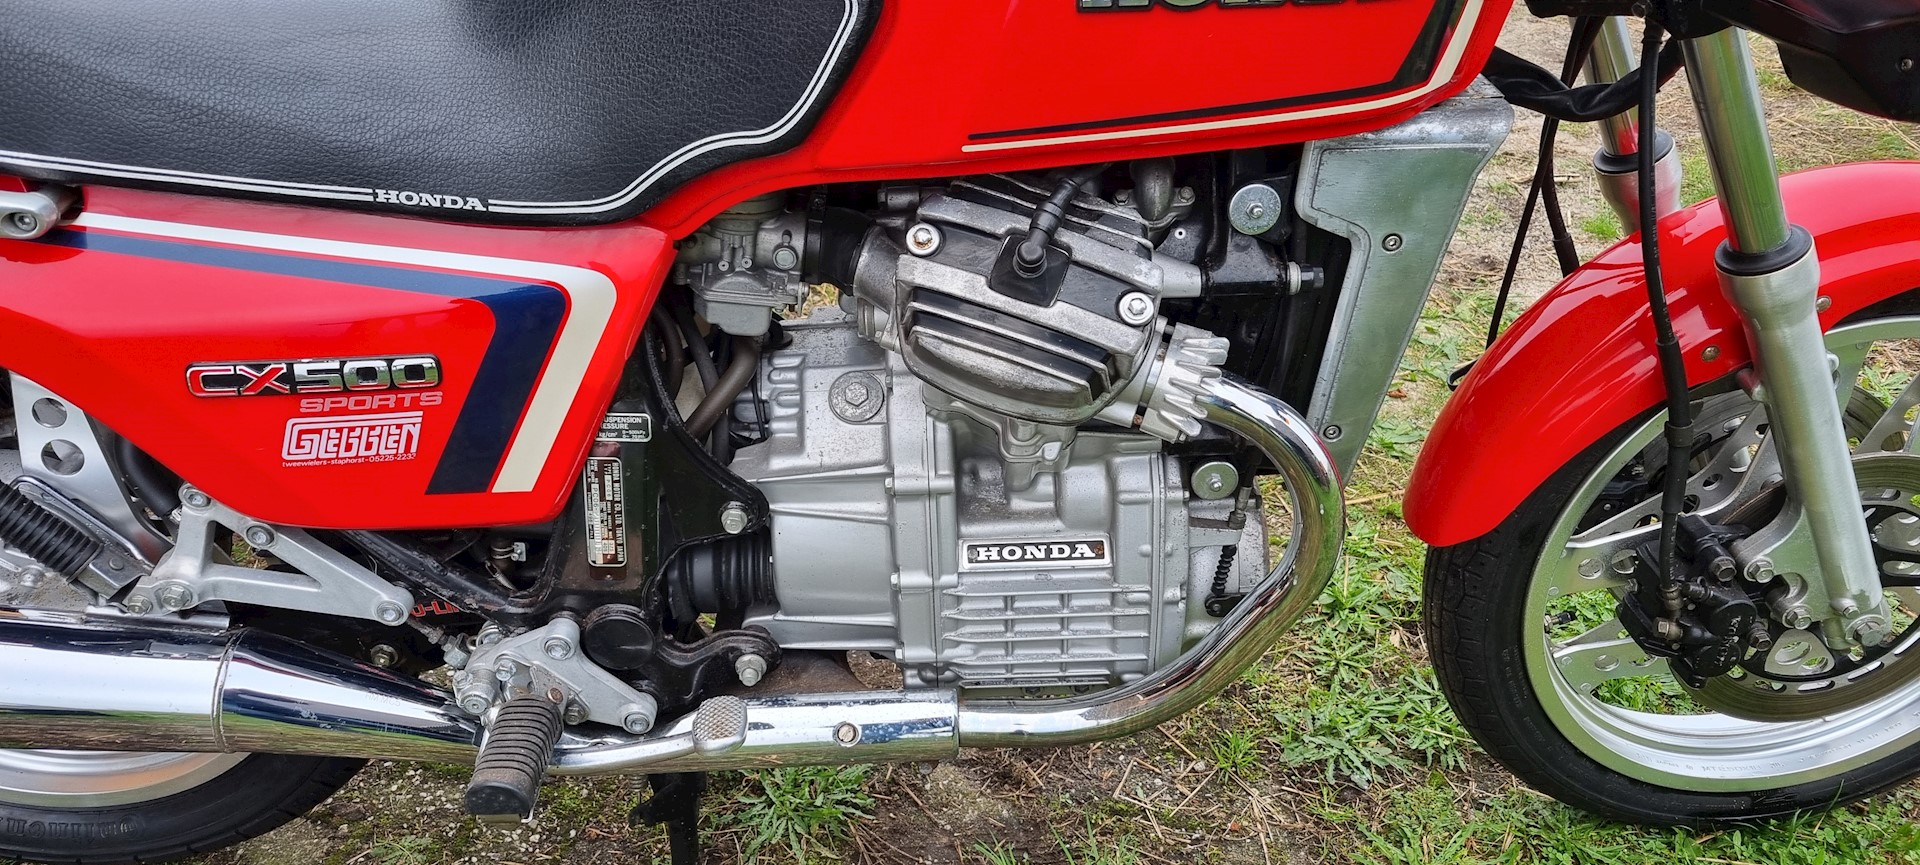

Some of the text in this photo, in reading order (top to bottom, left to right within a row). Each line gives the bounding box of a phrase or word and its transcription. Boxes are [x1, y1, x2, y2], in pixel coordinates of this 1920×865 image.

[375, 188, 487, 212] HONDA
[187, 357, 440, 397] CX500
[299, 391, 443, 413] SPORTS
[604, 416, 642, 424] USPENSION
[281, 410, 424, 461] GEBBEN
[612, 462, 621, 481] HONDA
[613, 482, 621, 502] MOTOR
[976, 543, 1096, 561] HONDA
